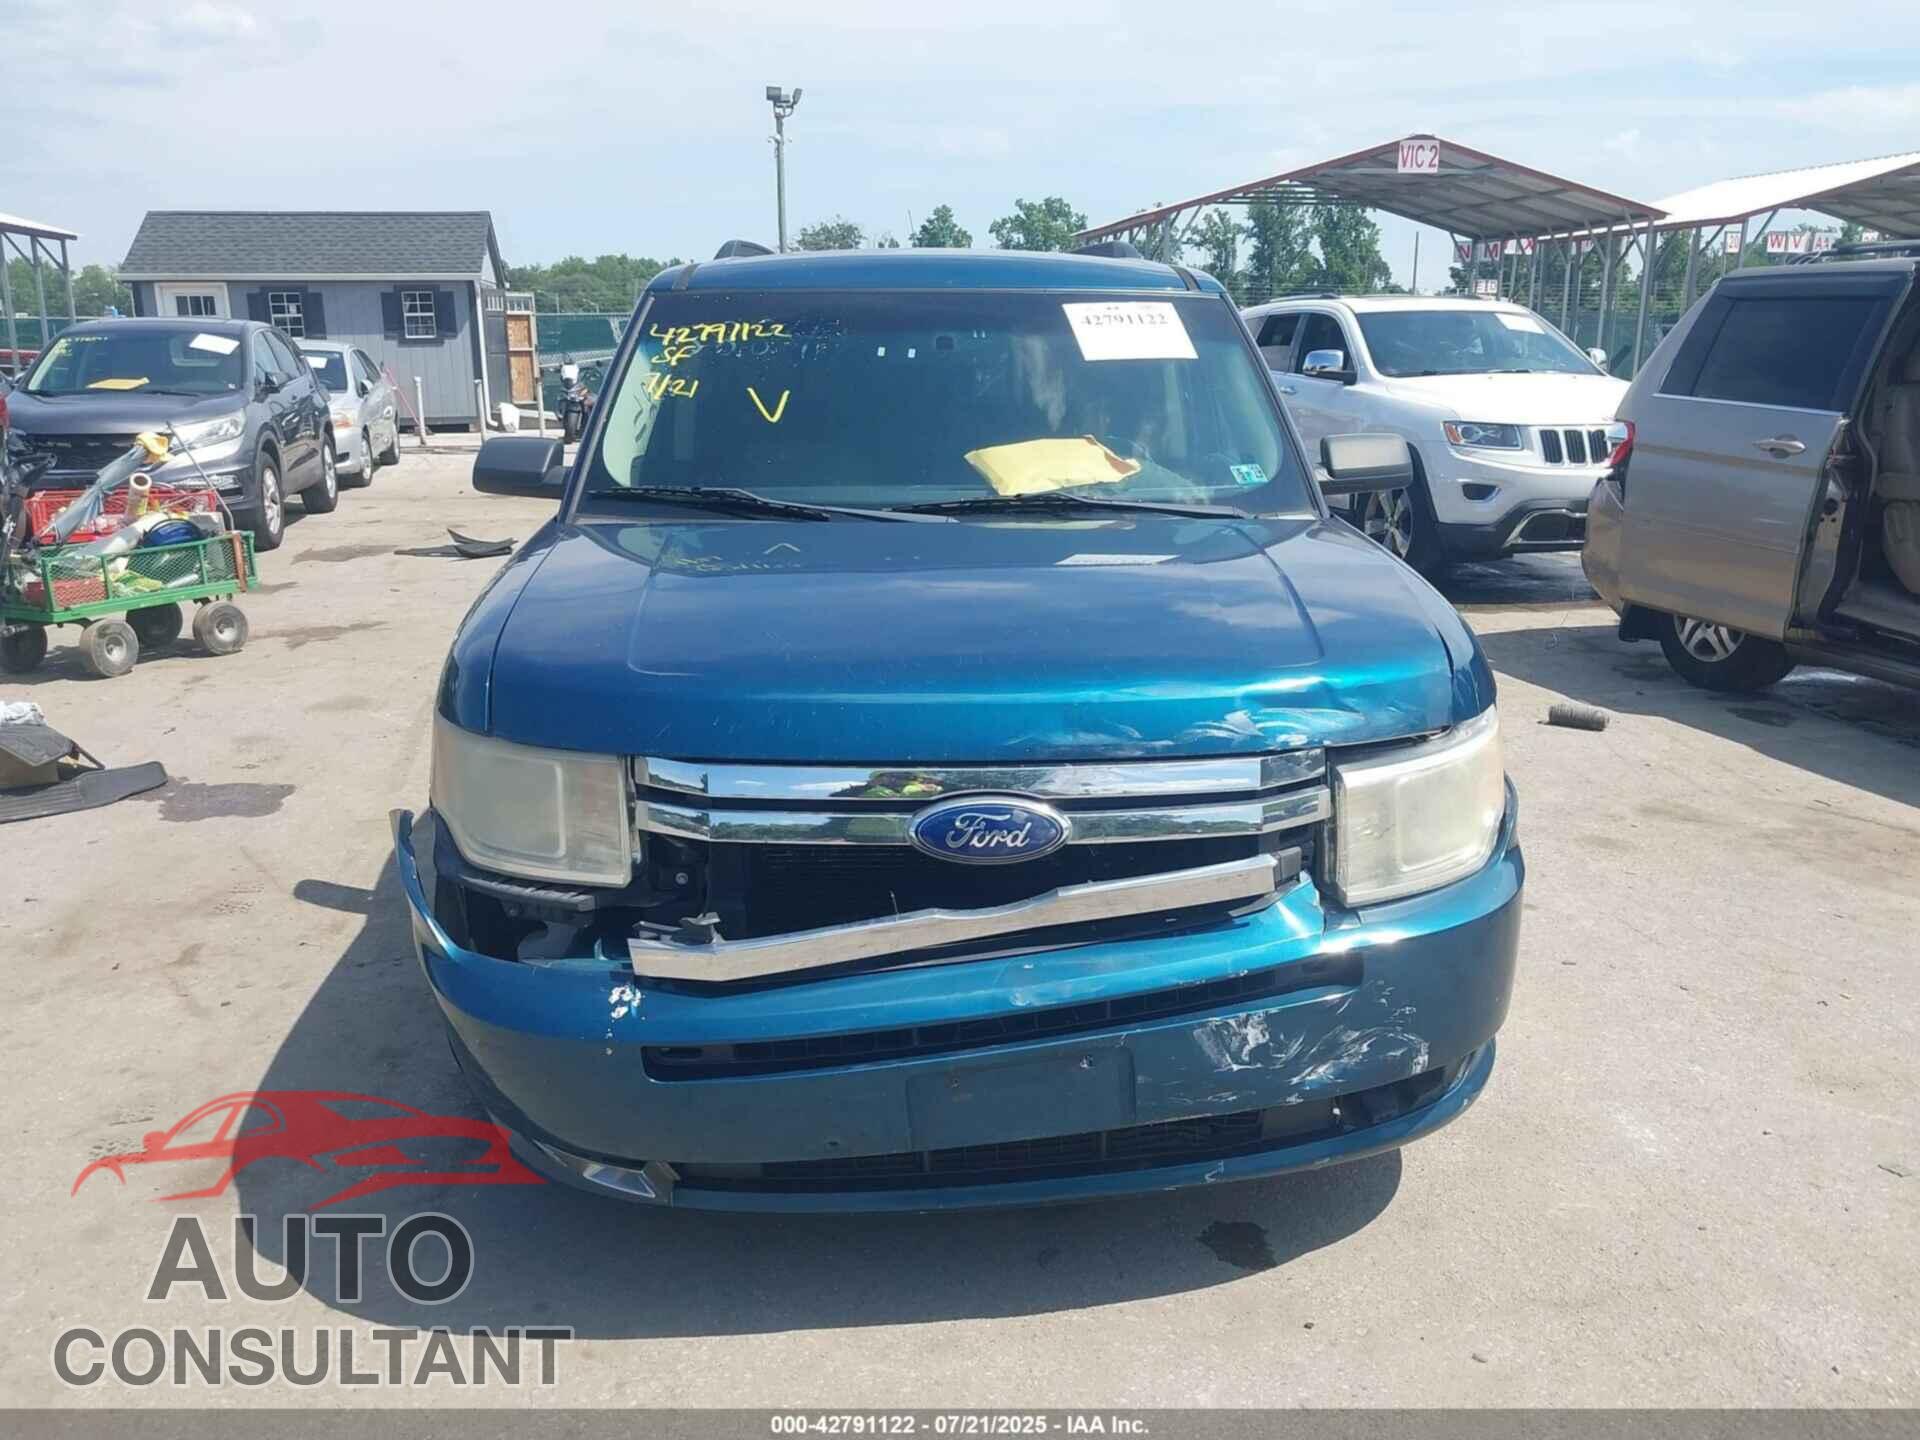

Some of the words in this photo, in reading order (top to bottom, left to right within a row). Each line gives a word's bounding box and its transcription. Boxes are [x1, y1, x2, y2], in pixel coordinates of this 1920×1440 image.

[1400, 144, 1425, 168] VIC
[1428, 145, 1438, 168] 2
[1769, 232, 1783, 248] W
[1792, 233, 1802, 248] V
[1081, 313, 1168, 326] 42791122
[649, 322, 791, 345] 42791122
[945, 812, 1033, 849] Ford
